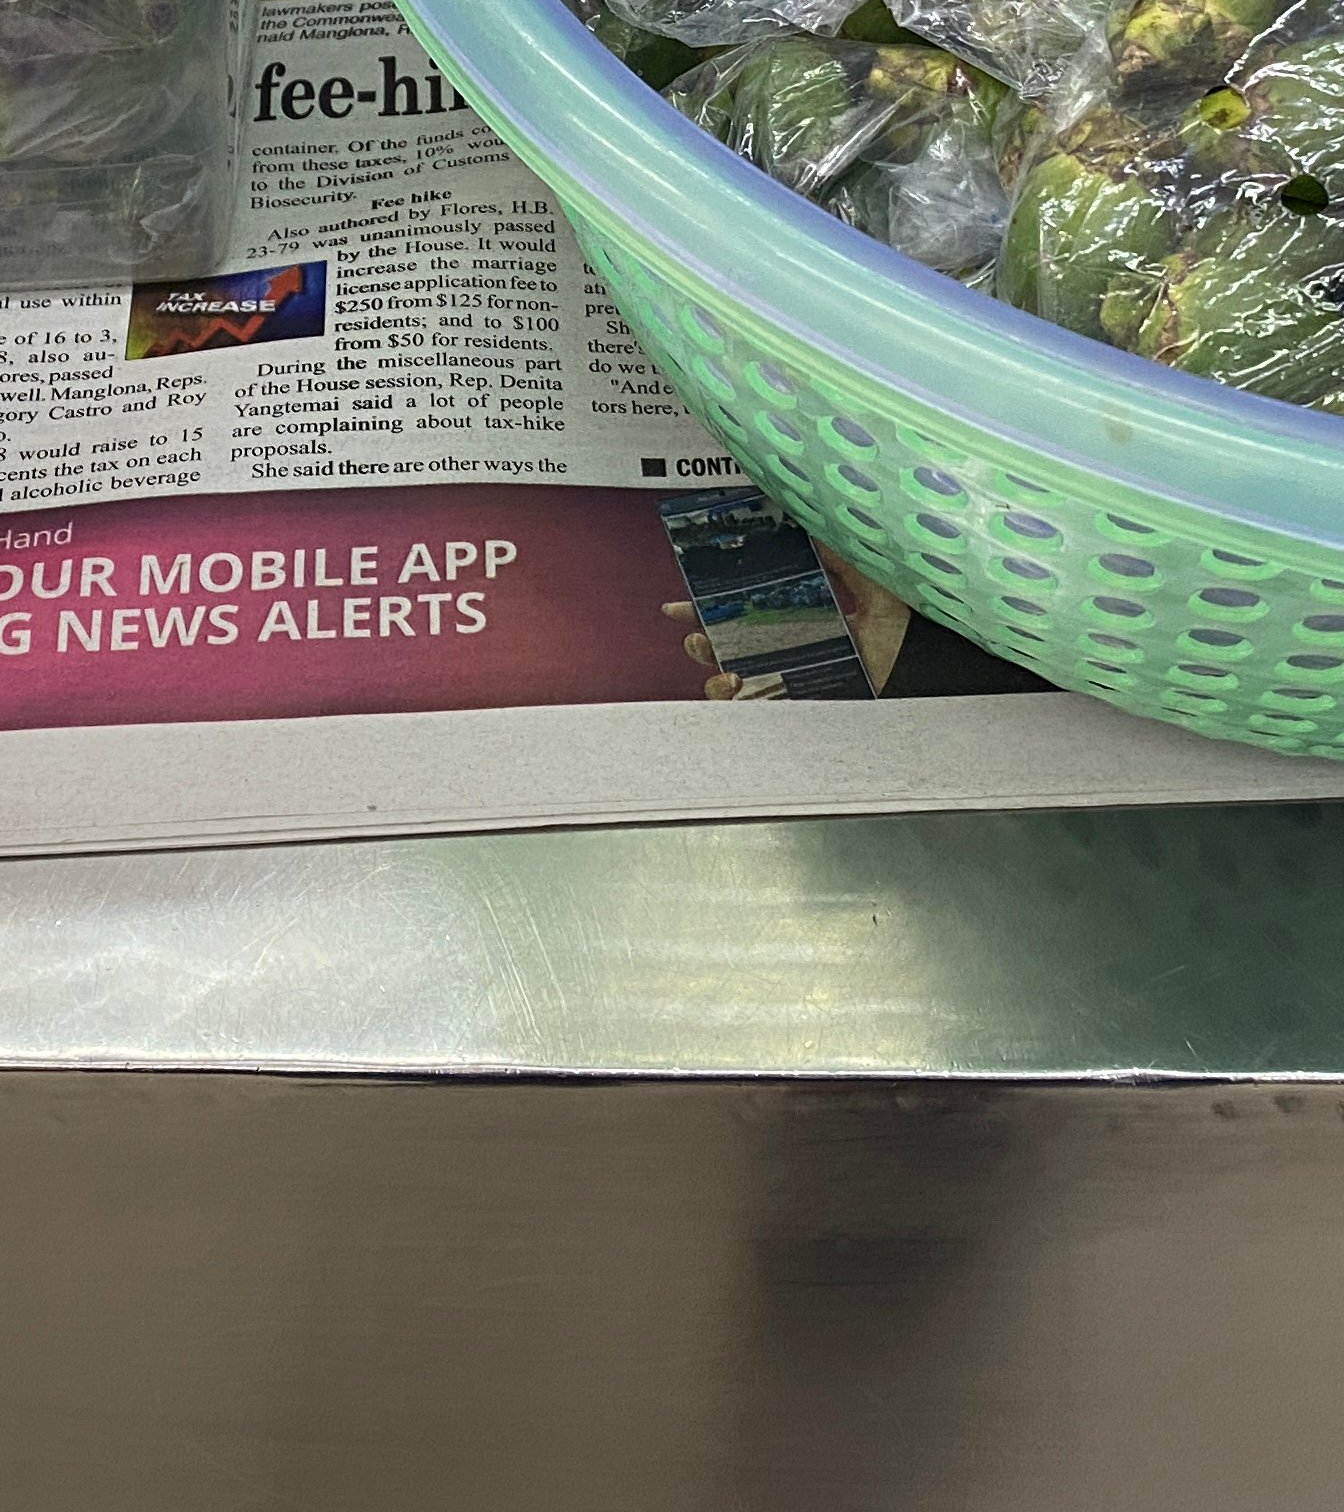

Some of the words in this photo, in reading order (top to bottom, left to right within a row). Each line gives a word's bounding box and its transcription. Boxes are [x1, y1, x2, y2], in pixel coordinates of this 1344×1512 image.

[292, 12, 406, 28] Commonwea
[253, 56, 468, 122] fee-hi
[371, 197, 405, 210] Fee
[411, 190, 452, 204] hike
[168, 292, 206, 301] TAX
[336, 280, 401, 296] license
[403, 274, 507, 293] application
[510, 276, 537, 291] fee
[540, 280, 558, 292] to
[156, 300, 276, 313] INCREASE
[334, 297, 384, 315] $250
[387, 295, 433, 310] from
[436, 293, 483, 308] $125
[487, 293, 514, 310] for
[515, 299, 559, 312] non-
[334, 315, 427, 333] residents;
[438, 313, 473, 328] and
[484, 316, 502, 329] to
[513, 315, 560, 332] $100
[334, 337, 381, 352] from
[387, 332, 425, 349] $50
[431, 332, 459, 347] for
[464, 334, 553, 352] residents.
[0, 387, 46, 402] well.
[50, 383, 152, 402] Manglona,
[156, 375, 207, 390] Reps.
[48, 405, 113, 421] Castro
[122, 395, 157, 413] and
[167, 392, 207, 407] Roy
[233, 396, 340, 418] Yangtemai
[352, 394, 393, 411] said
[405, 397, 417, 408] a
[430, 392, 455, 408] lot
[467, 393, 491, 408] of
[499, 395, 564, 414] people
[591, 399, 627, 414] tors
[631, 399, 679, 418] here,
[231, 426, 263, 438] are
[275, 415, 404, 437] complaining
[416, 413, 473, 429] about
[484, 415, 565, 432] tax-hike
[18, 442, 81, 461] would
[91, 439, 138, 454] raise
[149, 434, 168, 447] to
[182, 426, 203, 443] 15
[230, 439, 333, 463] proposals.
[54, 462, 84, 477] the
[90, 460, 119, 473] tax
[126, 456, 150, 469] on
[156, 447, 202, 465] each
[251, 462, 289, 479] She
[293, 460, 334, 477] said
[338, 459, 390, 476] there
[393, 461, 425, 473] are
[428, 455, 481, 472] other
[483, 460, 534, 475] ways
[538, 457, 568, 474] the
[10, 478, 103, 501] alcoholic
[110, 471, 201, 490] beverage
[140, 546, 378, 595] MOBILE
[398, 540, 516, 583] APP
[57, 605, 238, 652] NEWS
[258, 592, 486, 641] ALERTS
